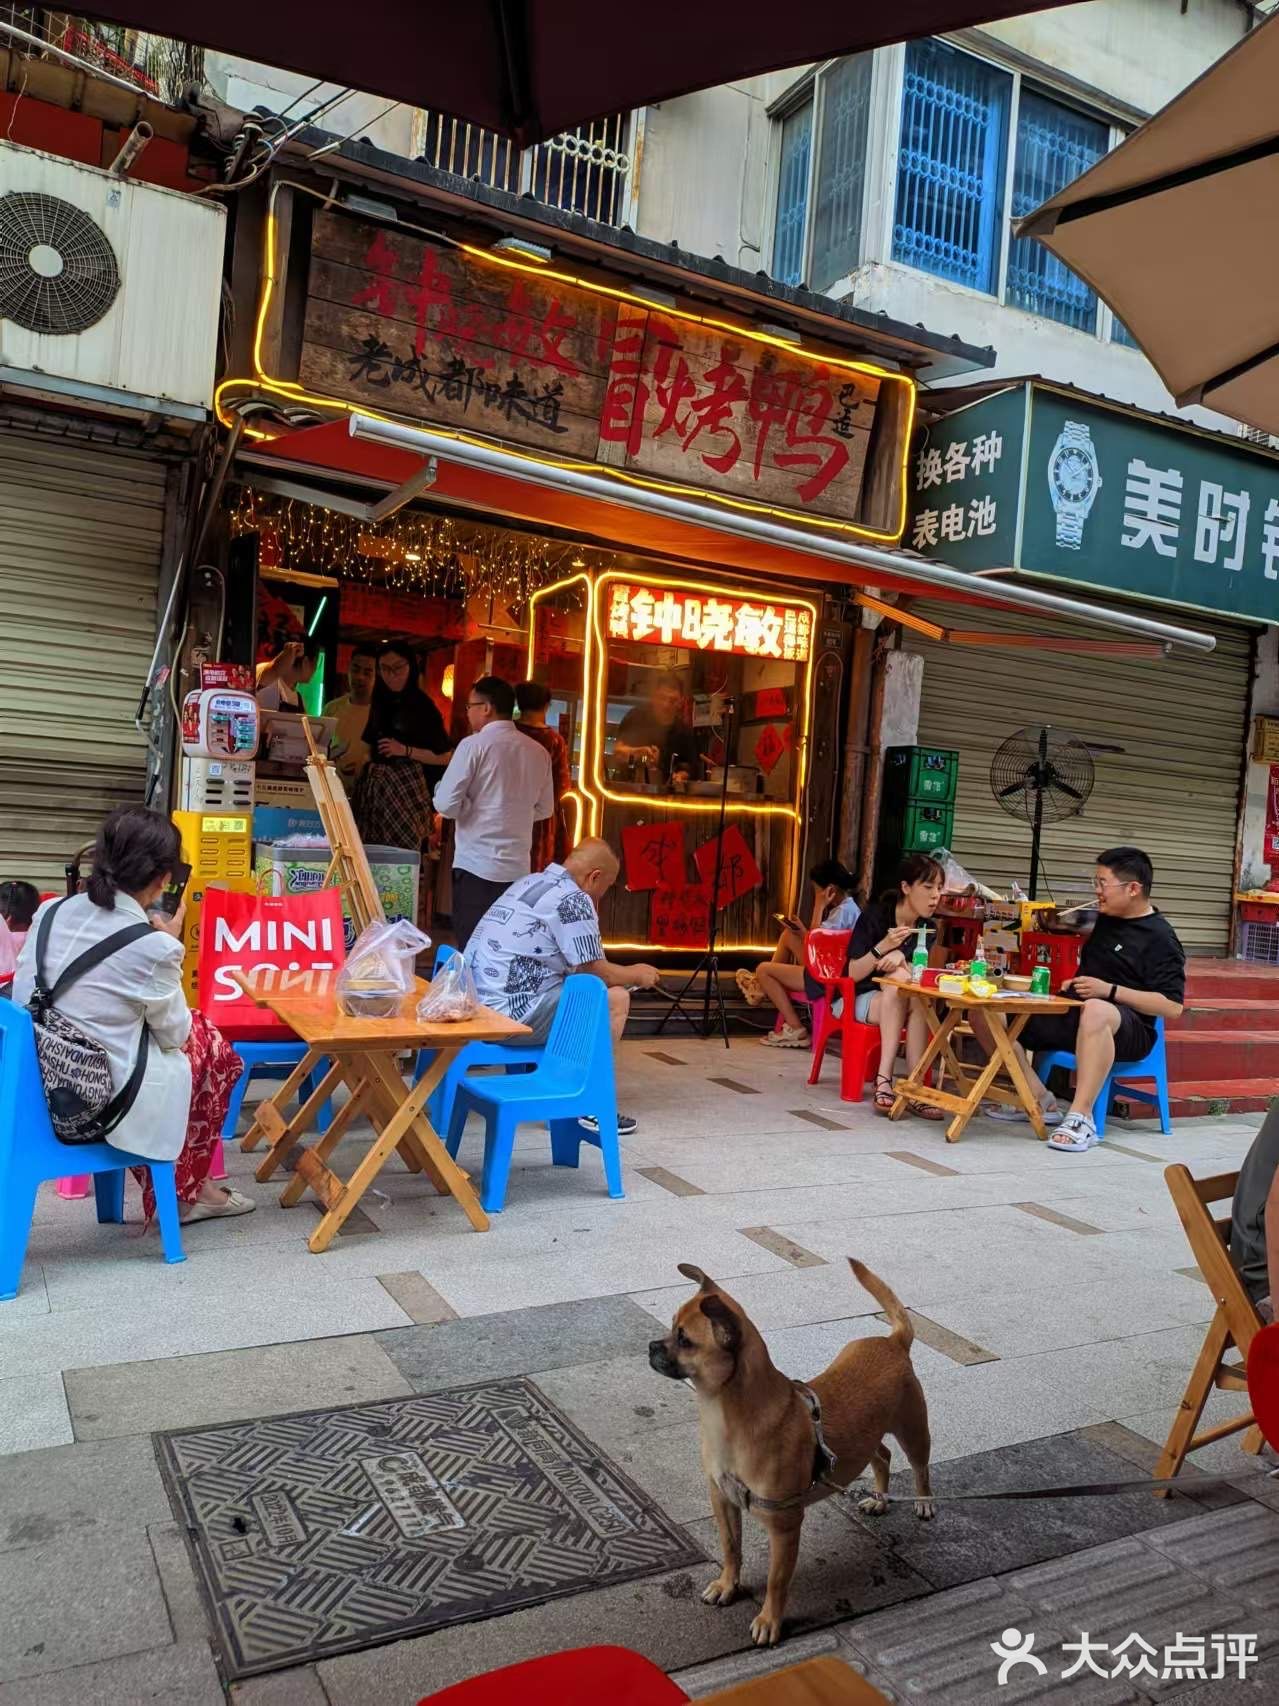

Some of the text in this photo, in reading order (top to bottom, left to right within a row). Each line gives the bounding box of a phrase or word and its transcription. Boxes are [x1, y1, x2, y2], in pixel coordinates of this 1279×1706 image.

[349, 333, 569, 434] 老成都味道
[916, 430, 1003, 491] 换各种
[912, 495, 998, 550] 表电池
[630, 587, 785, 658] 钟晓敏
[214, 917, 333, 952] MINI
